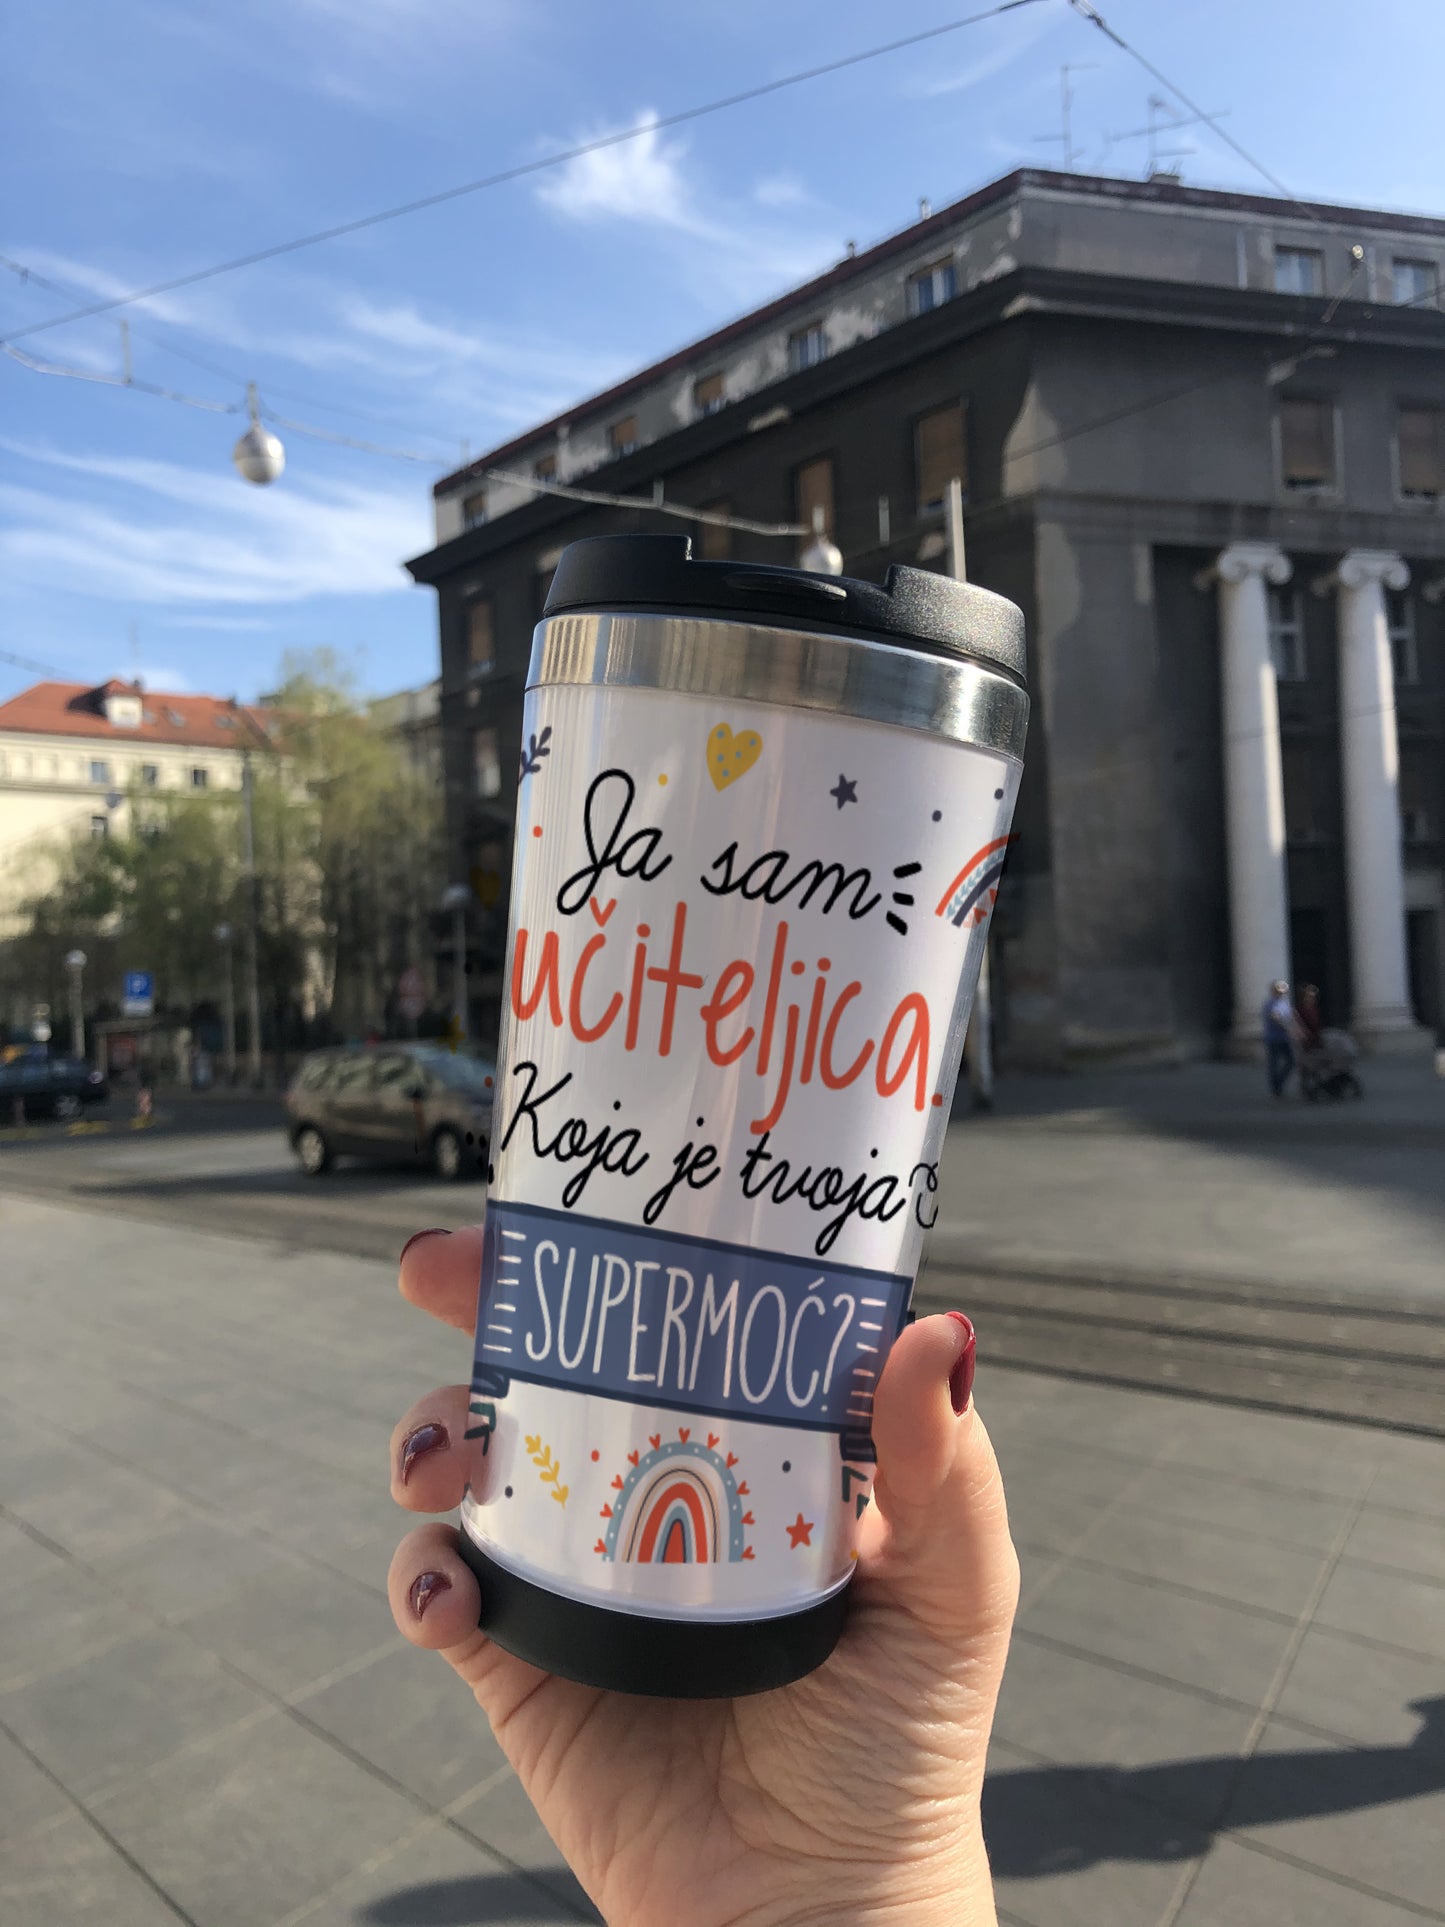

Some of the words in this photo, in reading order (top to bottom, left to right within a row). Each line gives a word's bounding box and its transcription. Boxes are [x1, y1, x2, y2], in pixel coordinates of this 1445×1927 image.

[557, 768, 673, 915] Ja
[701, 842, 882, 919] sam
[511, 896, 944, 1136] učiteljica.
[501, 1061, 650, 1208] Koja
[642, 1117, 721, 1225] je
[739, 1132, 906, 1256] tvoja
[525, 1239, 855, 1411] SUPERMOĆ?
